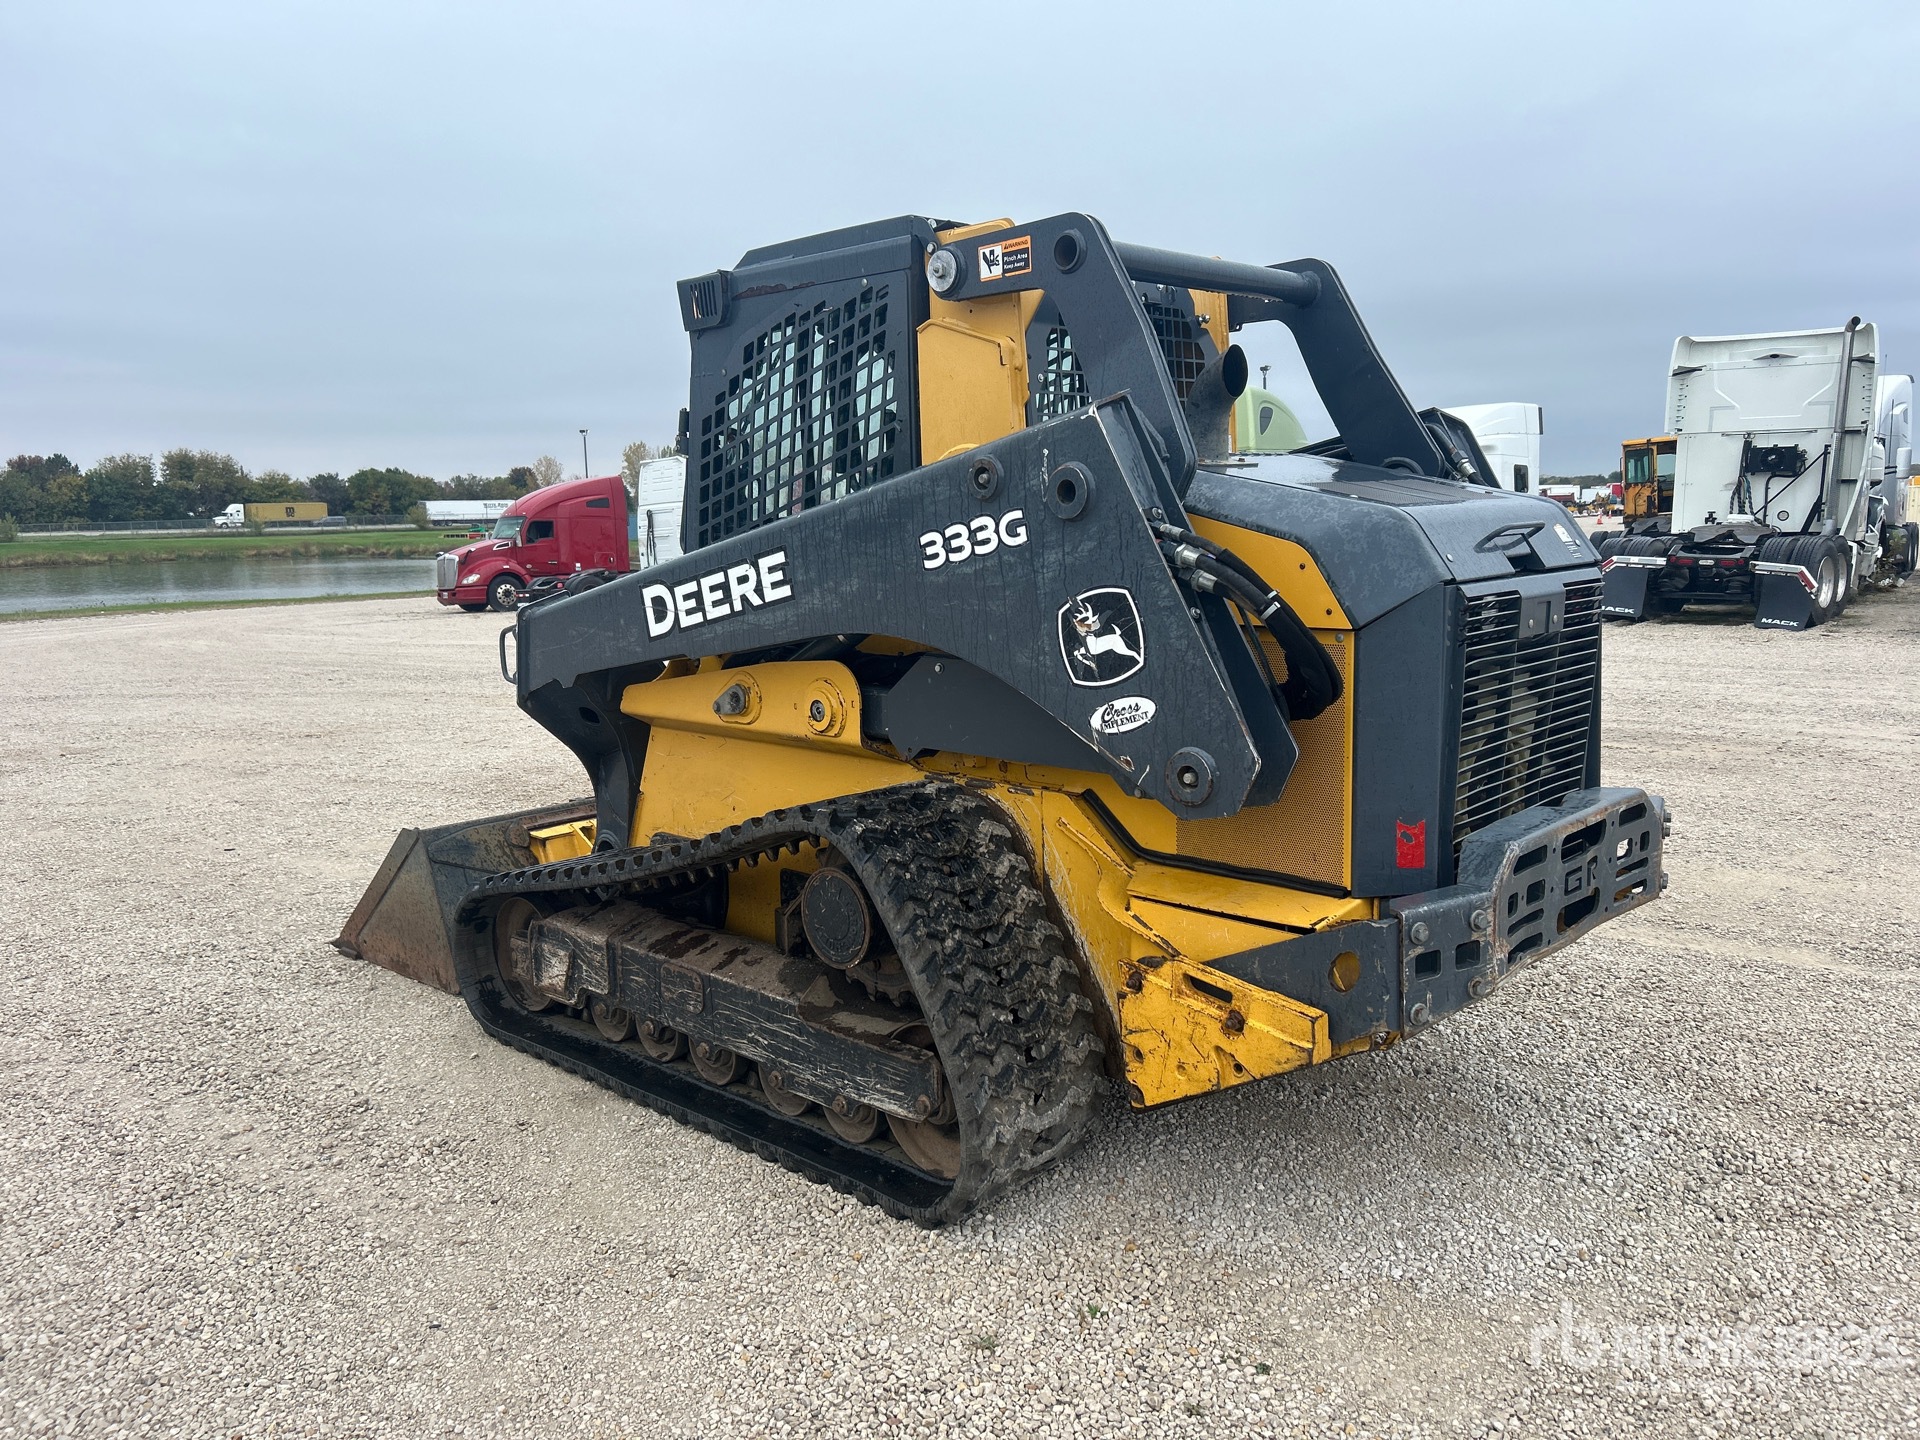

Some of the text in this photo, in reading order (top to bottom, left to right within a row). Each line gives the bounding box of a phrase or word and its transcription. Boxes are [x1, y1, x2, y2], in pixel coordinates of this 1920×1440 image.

[1006, 239, 1029, 249] WARNING
[1003, 252, 1028, 263] Pinch Area
[918, 509, 1029, 570] 333G
[641, 550, 793, 638] DEERE
[1760, 617, 1800, 627] MACK
